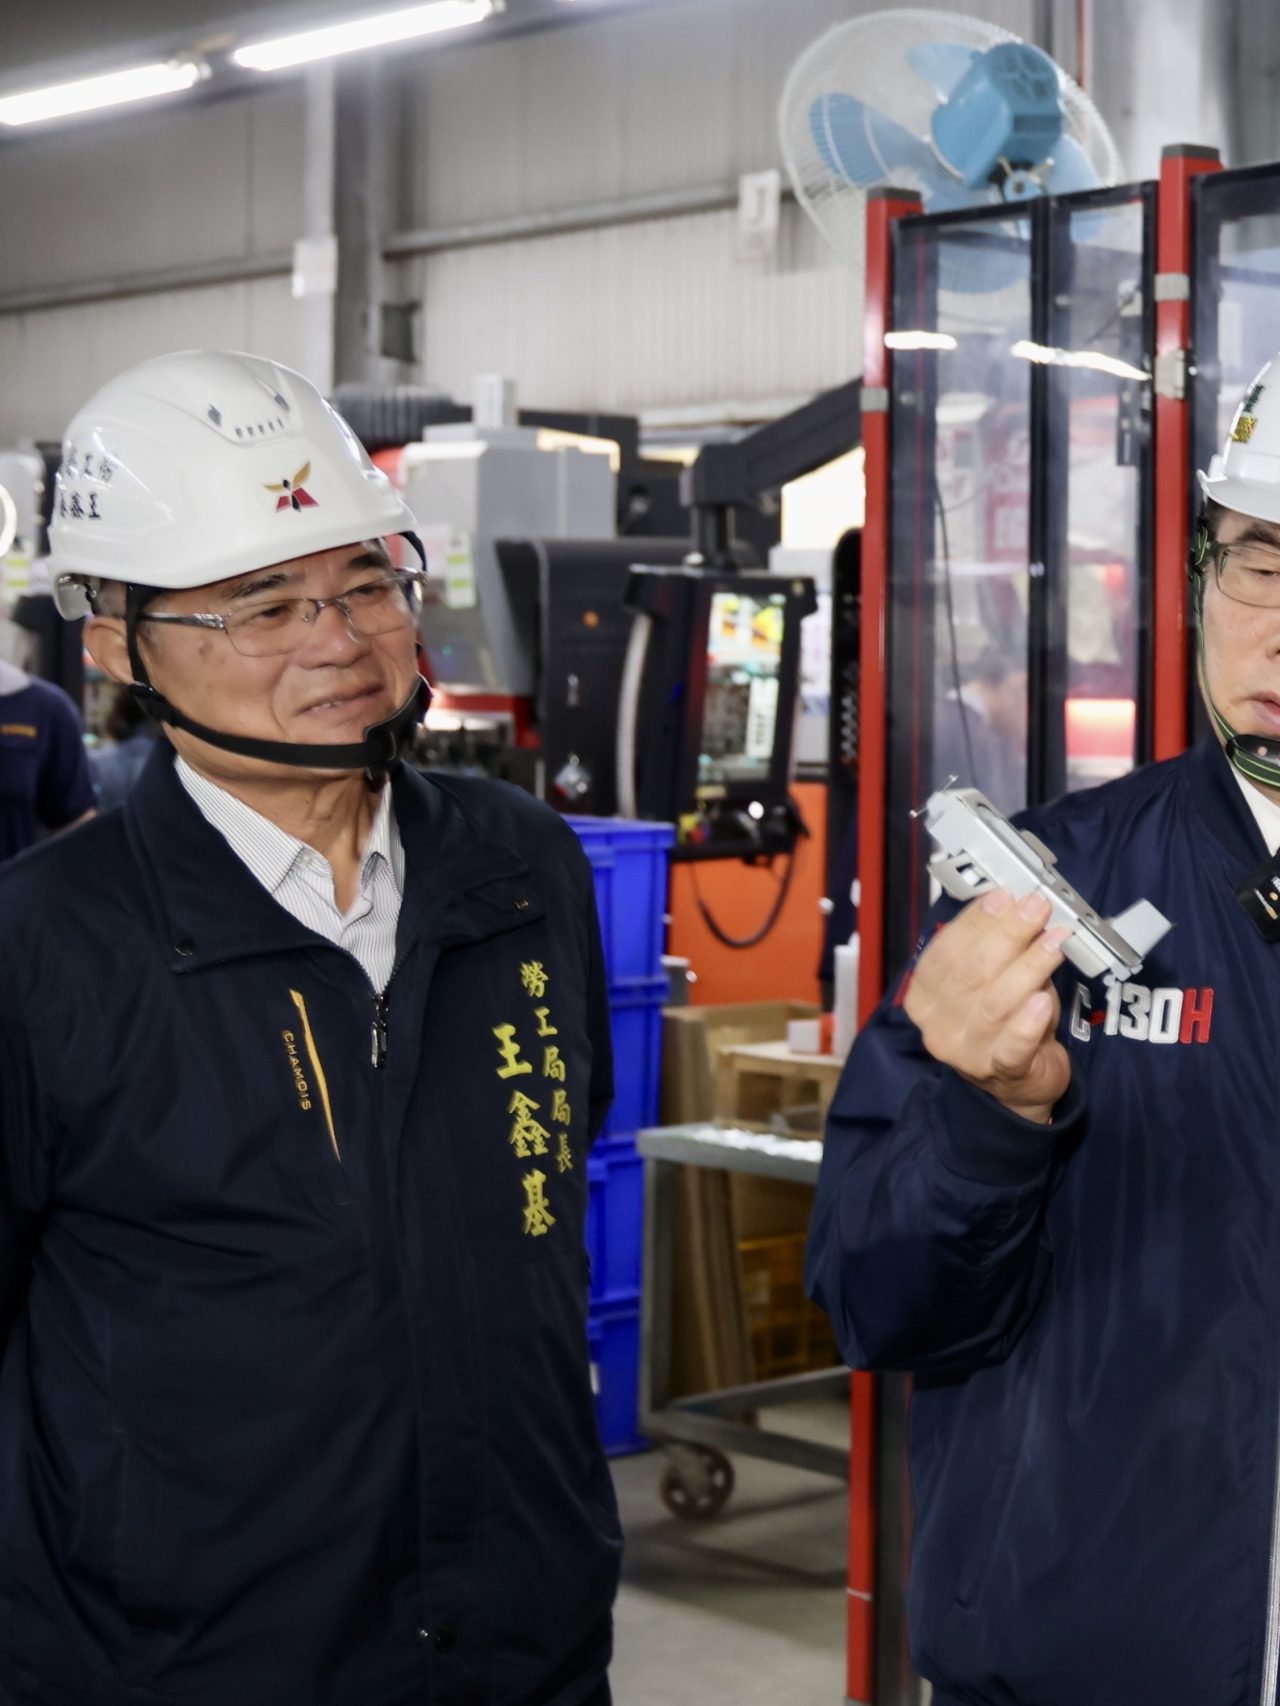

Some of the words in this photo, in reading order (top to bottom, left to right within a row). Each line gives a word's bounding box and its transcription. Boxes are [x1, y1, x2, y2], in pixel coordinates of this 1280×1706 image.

[282, 1029, 312, 1110] CHAMOIS
[520, 960, 573, 1173] 勞工局局長
[1071, 981, 1214, 1044] C-130H
[492, 1022, 556, 1237] 王鑫基
